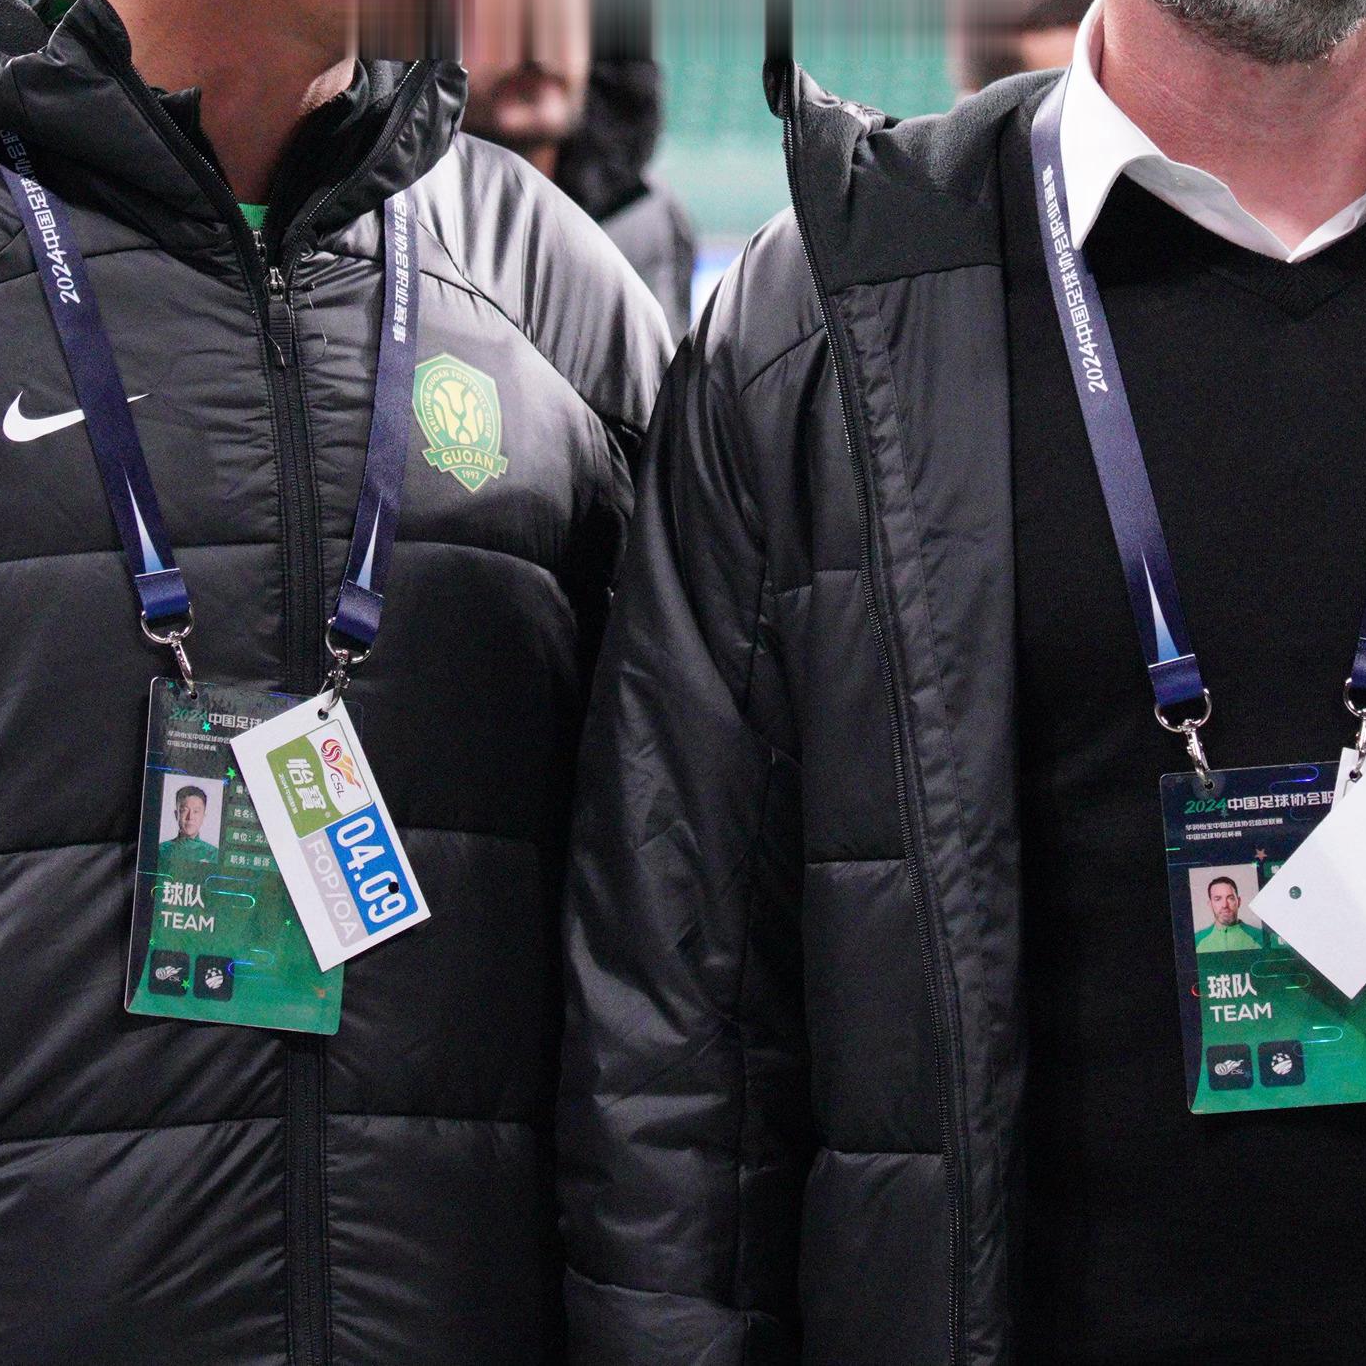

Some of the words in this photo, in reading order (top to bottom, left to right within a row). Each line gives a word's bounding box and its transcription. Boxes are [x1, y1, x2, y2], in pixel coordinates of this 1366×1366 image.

[1042, 165, 1108, 393] 2024中国足球协会职业赛事
[441, 450, 495, 471] GUOAN
[329, 772, 346, 799] CSL
[336, 816, 407, 923] 04.09
[162, 881, 205, 908] 球队
[307, 841, 358, 940] FOP/OA
[161, 911, 215, 933] TEAM
[1207, 973, 1257, 999] 球队
[1209, 1002, 1273, 1023] TEAM
